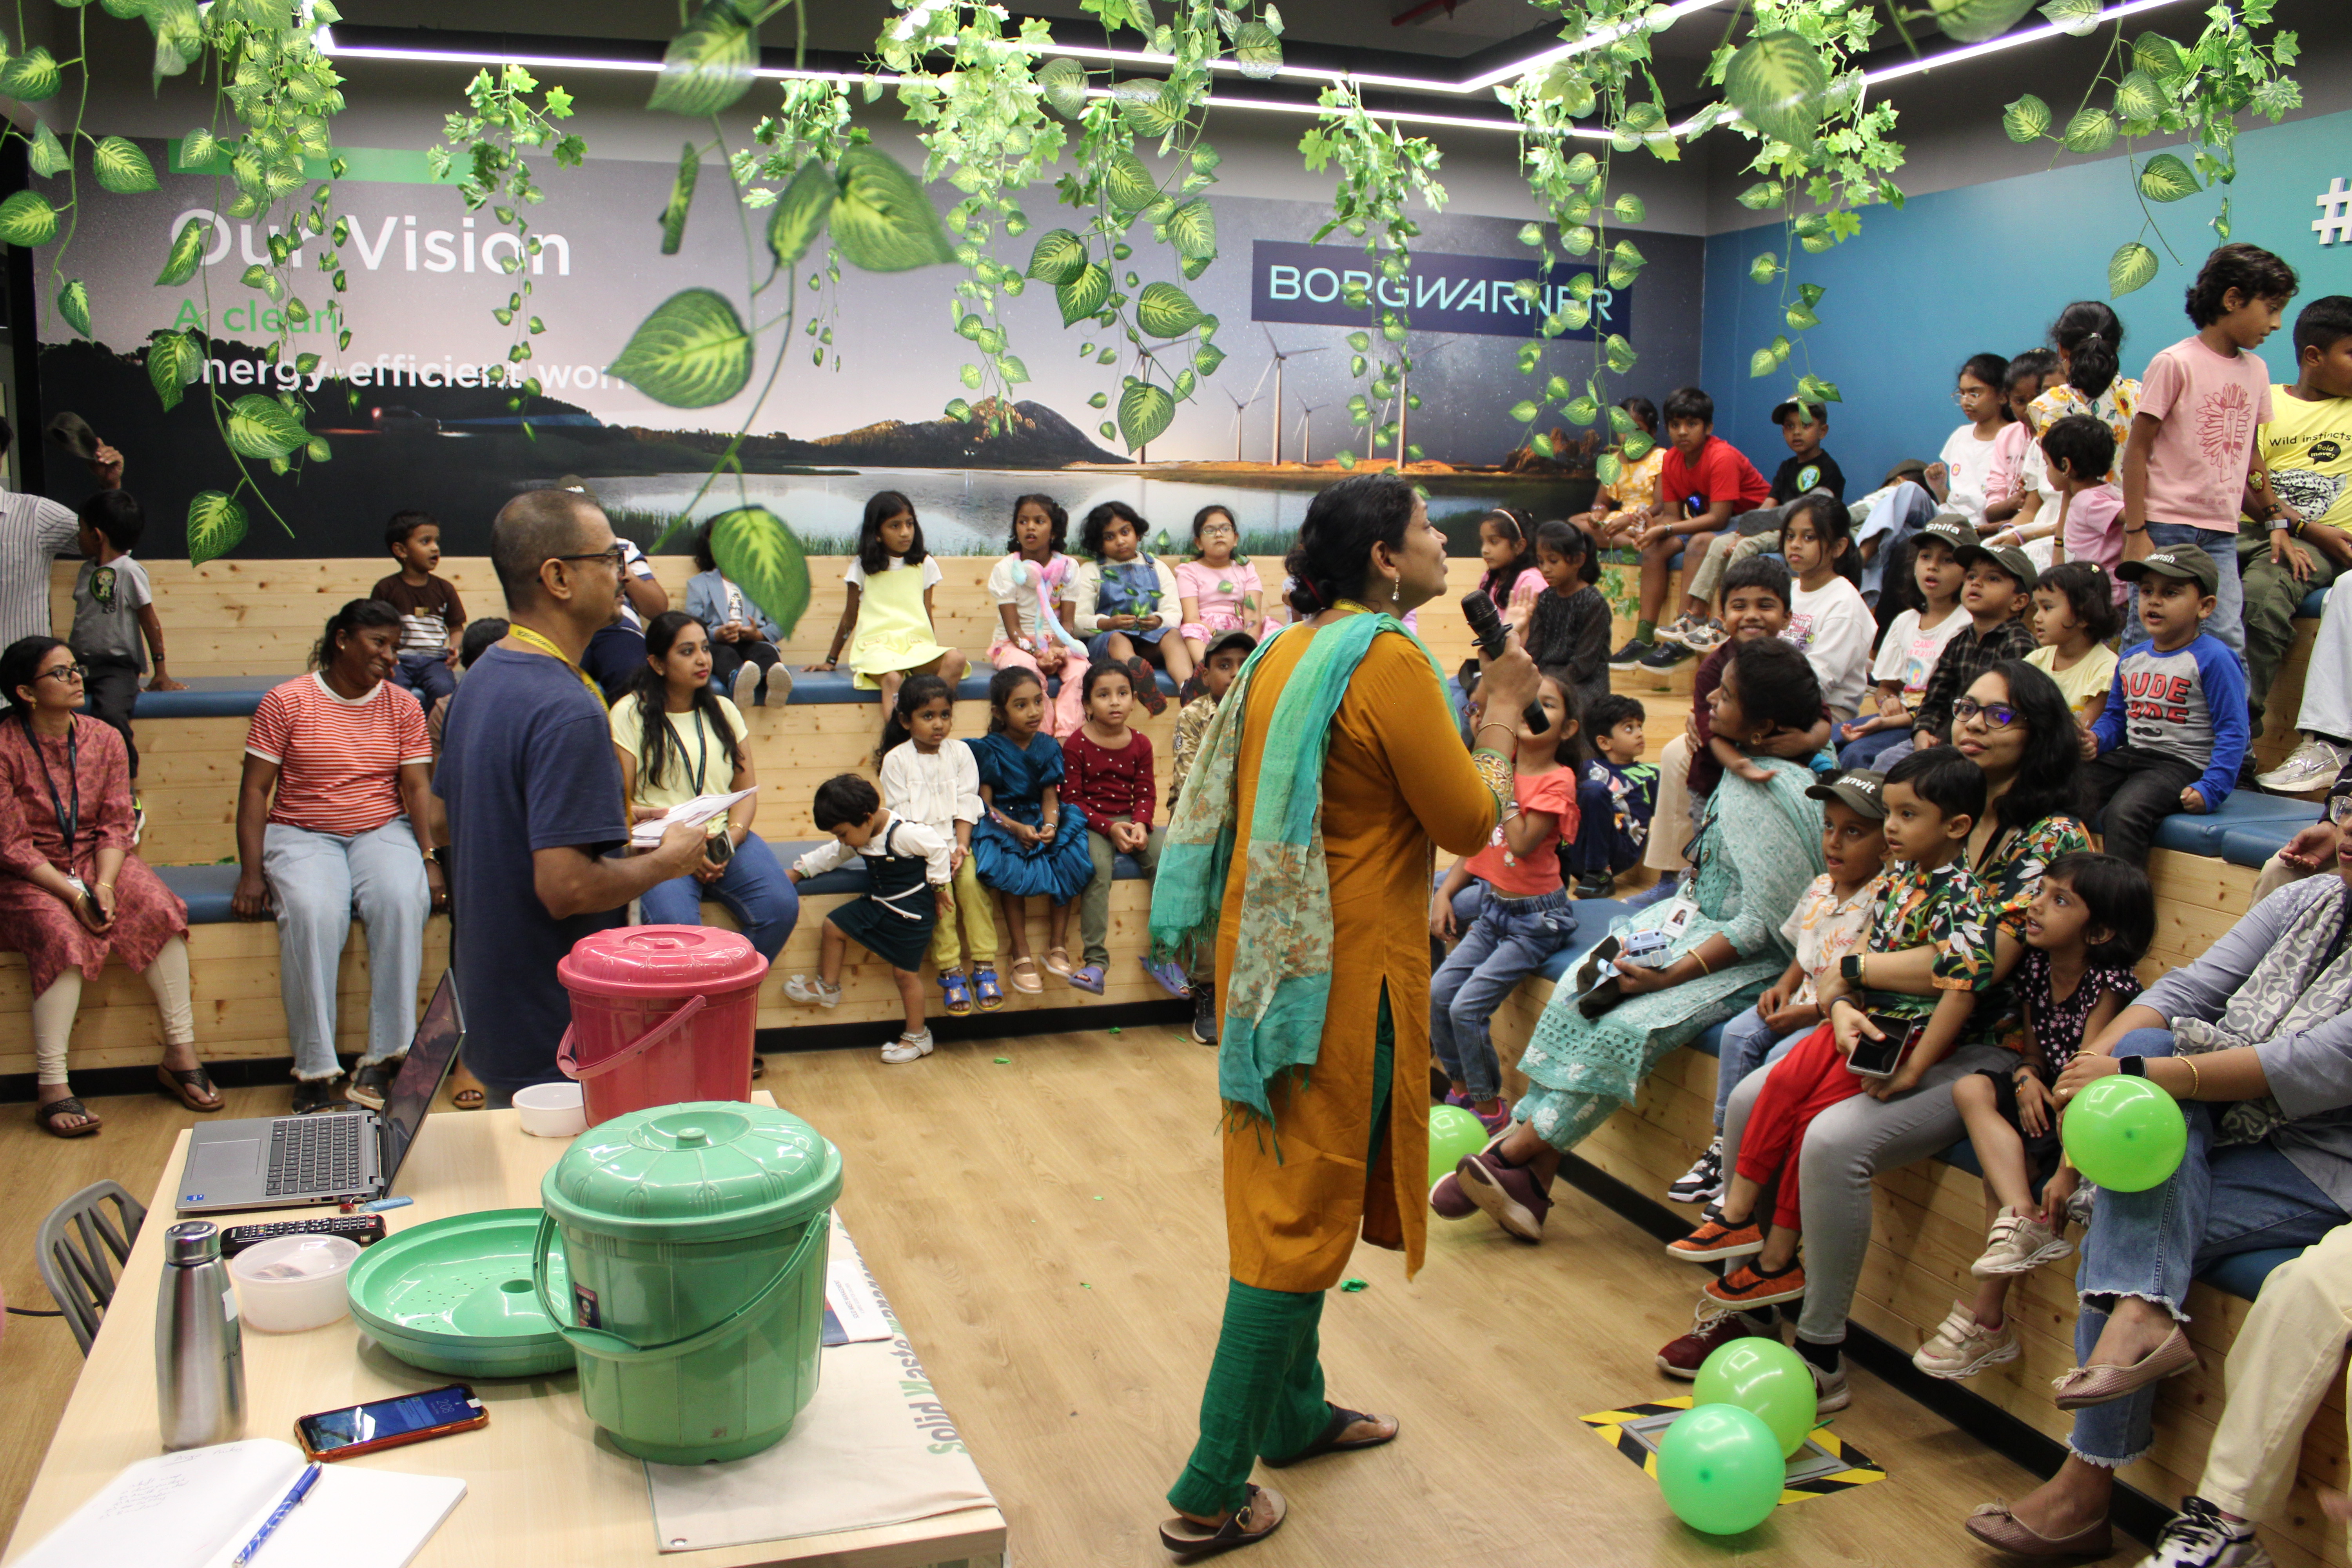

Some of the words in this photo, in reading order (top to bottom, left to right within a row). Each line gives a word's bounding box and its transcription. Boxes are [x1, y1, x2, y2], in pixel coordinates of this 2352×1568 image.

[171, 209, 316, 268] Our
[346, 214, 570, 276] Vision
[1269, 265, 1613, 321] BORGWARNER
[174, 299, 205, 332] A
[202, 353, 522, 392] nergy-efficient
[537, 364, 640, 390] wor
[2269, 436, 2297, 446] Wild
[2317, 444, 2335, 452] Bold
[1925, 523, 1960, 535] Shifa
[1837, 776, 1877, 794] Anvit
[908, 1401, 968, 1455] Solid
